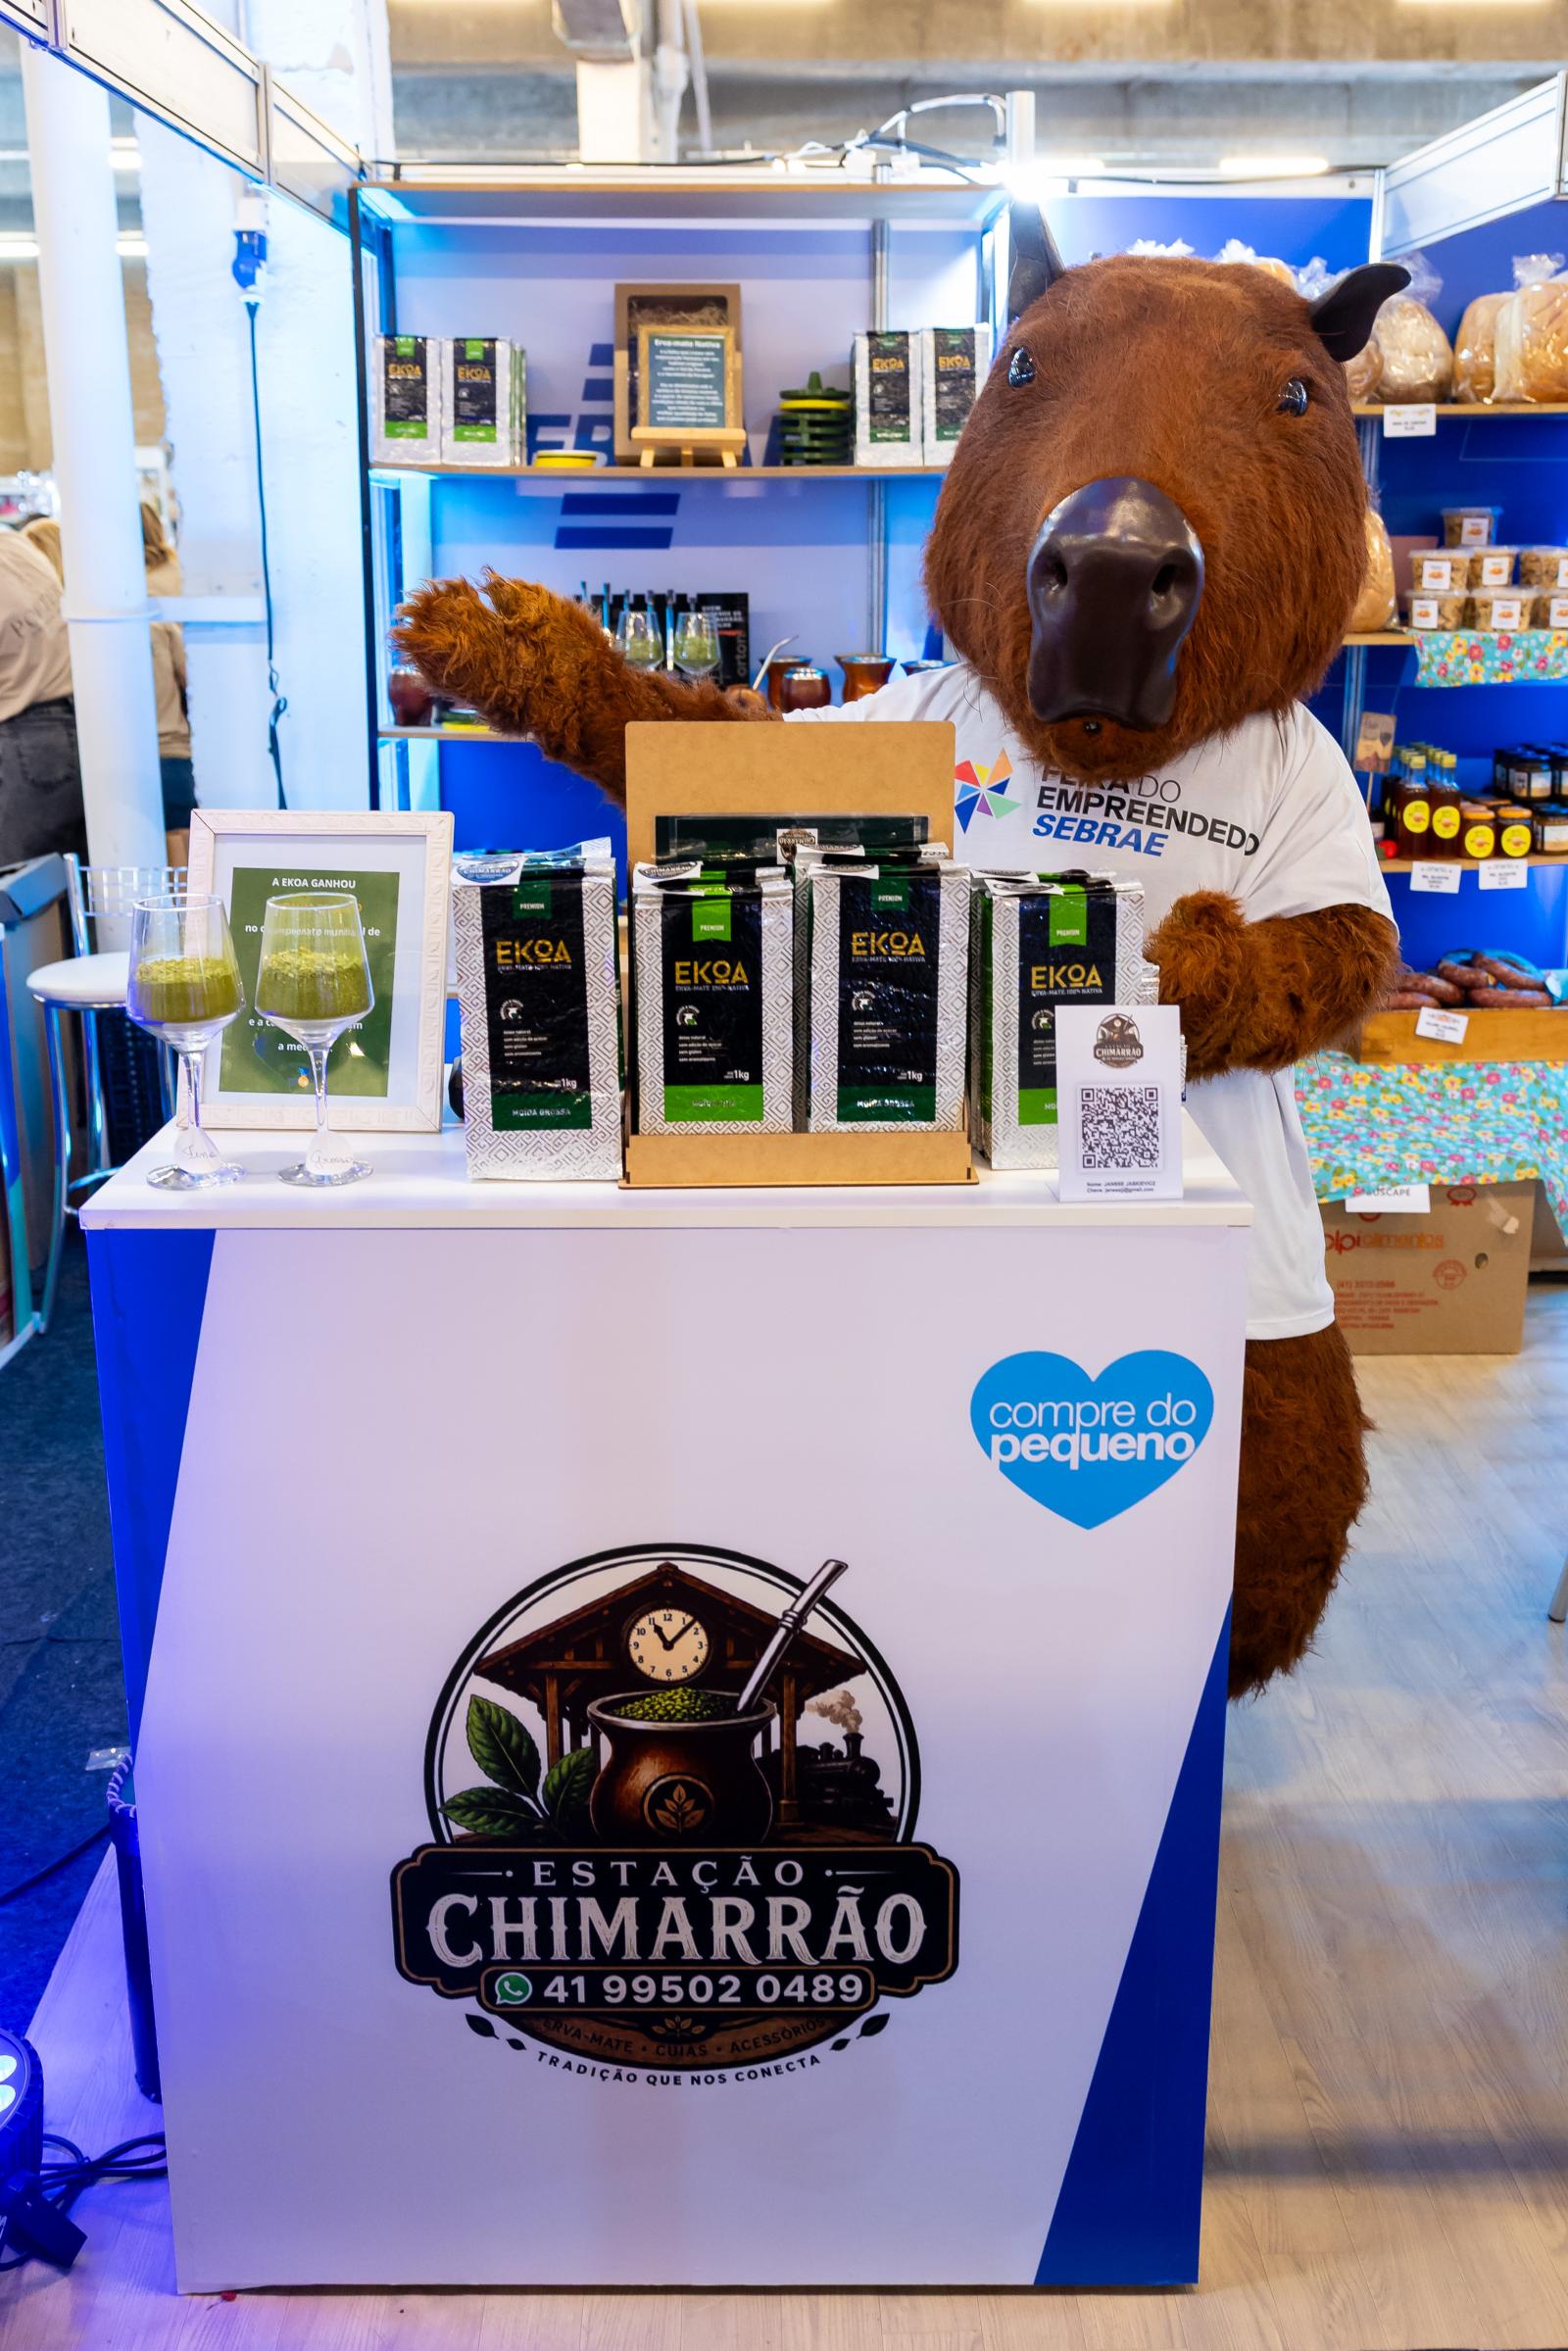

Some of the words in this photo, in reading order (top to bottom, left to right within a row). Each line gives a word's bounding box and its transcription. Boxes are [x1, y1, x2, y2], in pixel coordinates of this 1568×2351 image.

[388, 364, 422, 377] EKOA
[457, 366, 492, 380] EKOA
[872, 357, 905, 370] EKOA
[938, 355, 971, 368] EKOA
[1138, 774, 1181, 803] DO
[1032, 813, 1169, 857] SEBRAE
[271, 878, 280, 887] A
[281, 878, 309, 888] EKOA
[311, 879, 357, 889] GANHOU
[368, 927, 380, 936] de
[851, 932, 926, 955] EKOA
[496, 940, 571, 964] EKOA
[674, 960, 749, 984] EKOA
[1031, 963, 1102, 989] EKOA
[561, 1078, 577, 1089] 1kg
[734, 1069, 750, 1082] 1kg
[906, 1070, 923, 1082] 1kg
[989, 1399, 1136, 1434] compre
[1147, 1392, 1197, 1427] do
[991, 1431, 1196, 1470] pequeno
[532, 1854, 805, 1893] ESTAÇÃO
[424, 1885, 928, 1968] CHIMARRÃO
[544, 1976, 586, 2004] 41
[602, 1975, 742, 2004] 99502
[756, 1975, 864, 2004] 0489
[542, 2018, 634, 2054] ERVA-MATE
[655, 2043, 709, 2058] CUIAS
[729, 2016, 826, 2055] ACESSÓRIOS
[536, 2050, 639, 2084] TRADIÇÃO
[646, 2072, 683, 2087] QUE
[690, 2072, 727, 2086] NOS
[735, 2054, 822, 2083] CONECTA
